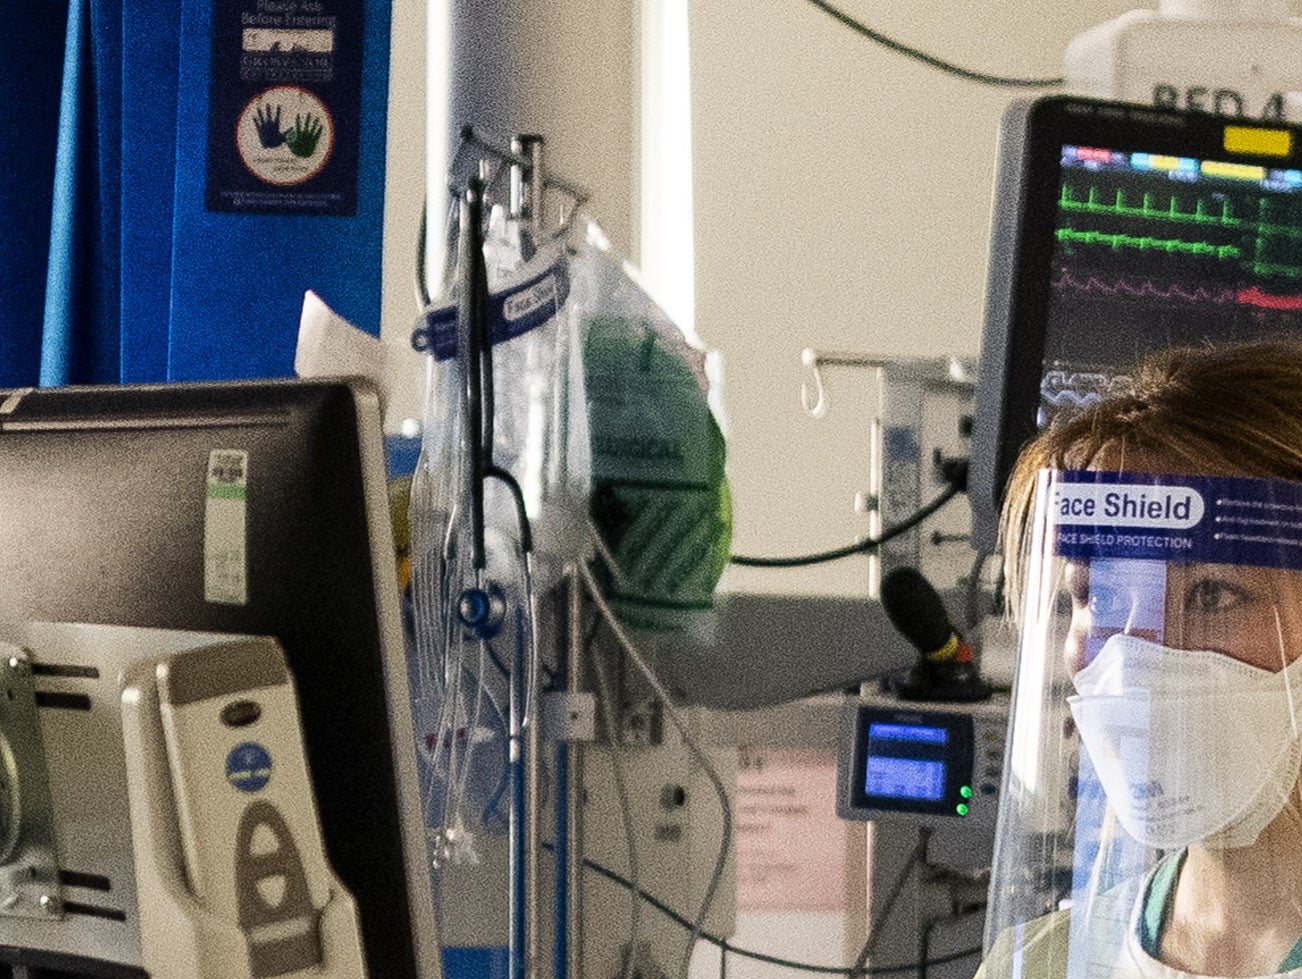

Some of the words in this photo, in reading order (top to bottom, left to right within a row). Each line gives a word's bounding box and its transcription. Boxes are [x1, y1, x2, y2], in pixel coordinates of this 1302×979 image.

[1104, 492, 1192, 520] Shield
[1080, 533, 1115, 546] SHIELD
[1116, 536, 1193, 549] PROTECTION
